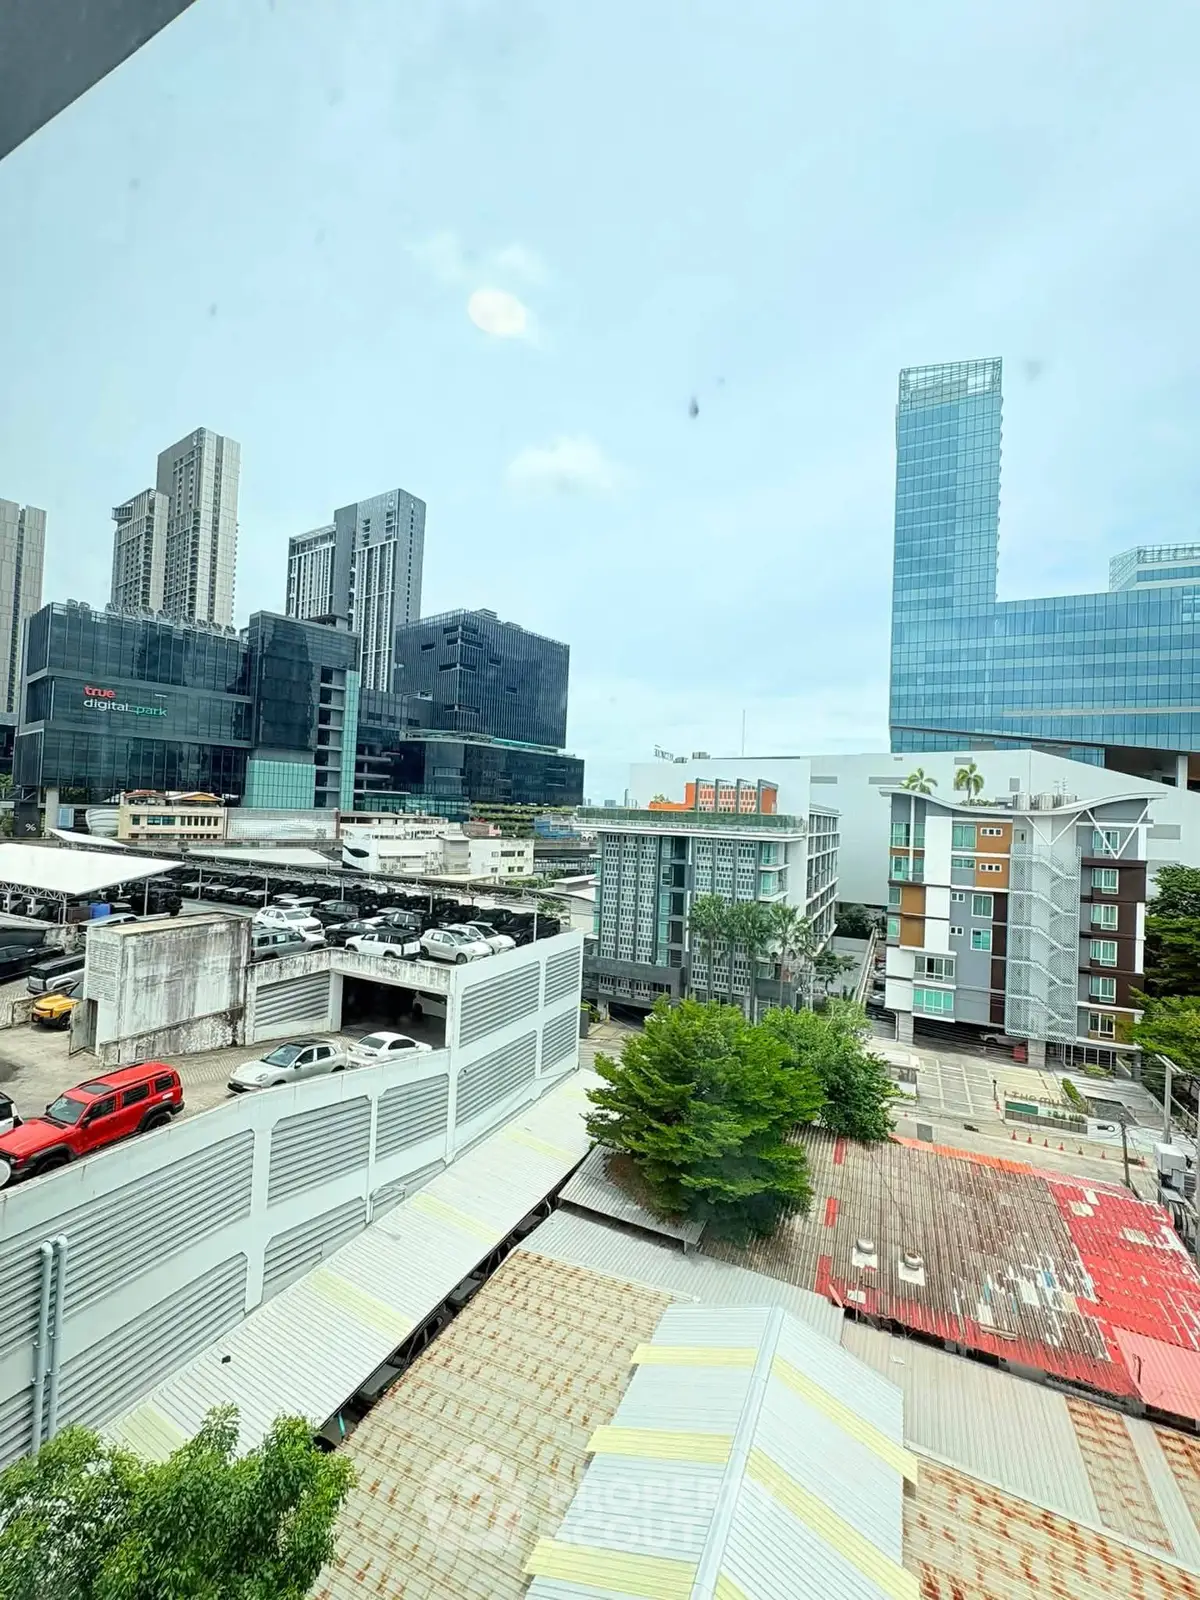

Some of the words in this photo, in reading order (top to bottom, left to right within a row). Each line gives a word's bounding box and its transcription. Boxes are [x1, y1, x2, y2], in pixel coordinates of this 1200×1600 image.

[83, 685, 116, 698] true
[83, 699, 129, 712] digital
[136, 705, 168, 716] park
